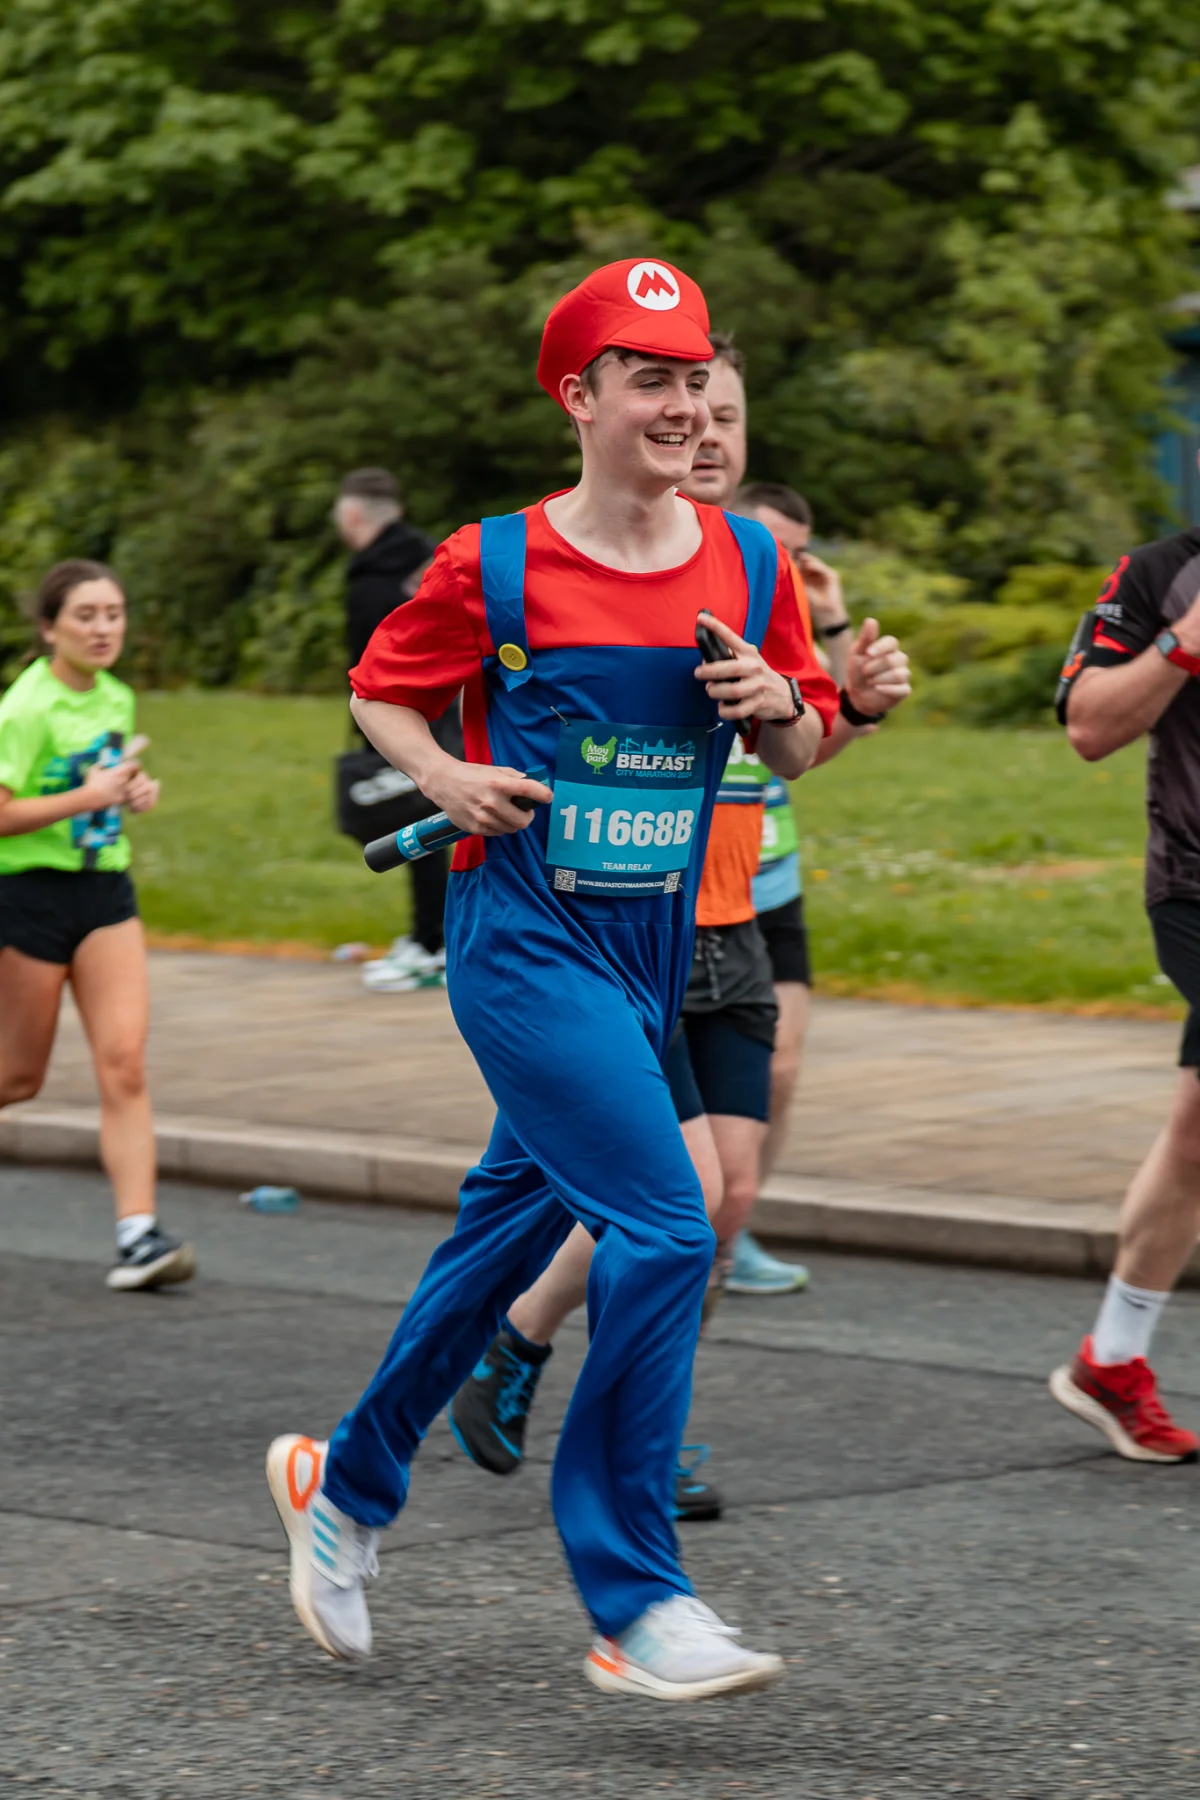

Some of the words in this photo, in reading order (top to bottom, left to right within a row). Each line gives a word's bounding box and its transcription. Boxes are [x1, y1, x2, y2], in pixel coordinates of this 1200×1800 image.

[635, 270, 676, 299] M
[587, 744, 610, 757] Moy
[586, 754, 609, 764] park
[616, 753, 695, 771] BELFAST
[615, 769, 634, 777] CITY
[635, 769, 677, 778] MARATHON
[560, 804, 695, 847] 11668B
[602, 861, 626, 871] TEAM
[627, 863, 652, 871] RELAY
[577, 879, 665, 889] WWW.BELFASTCITYMARATHON.COM
